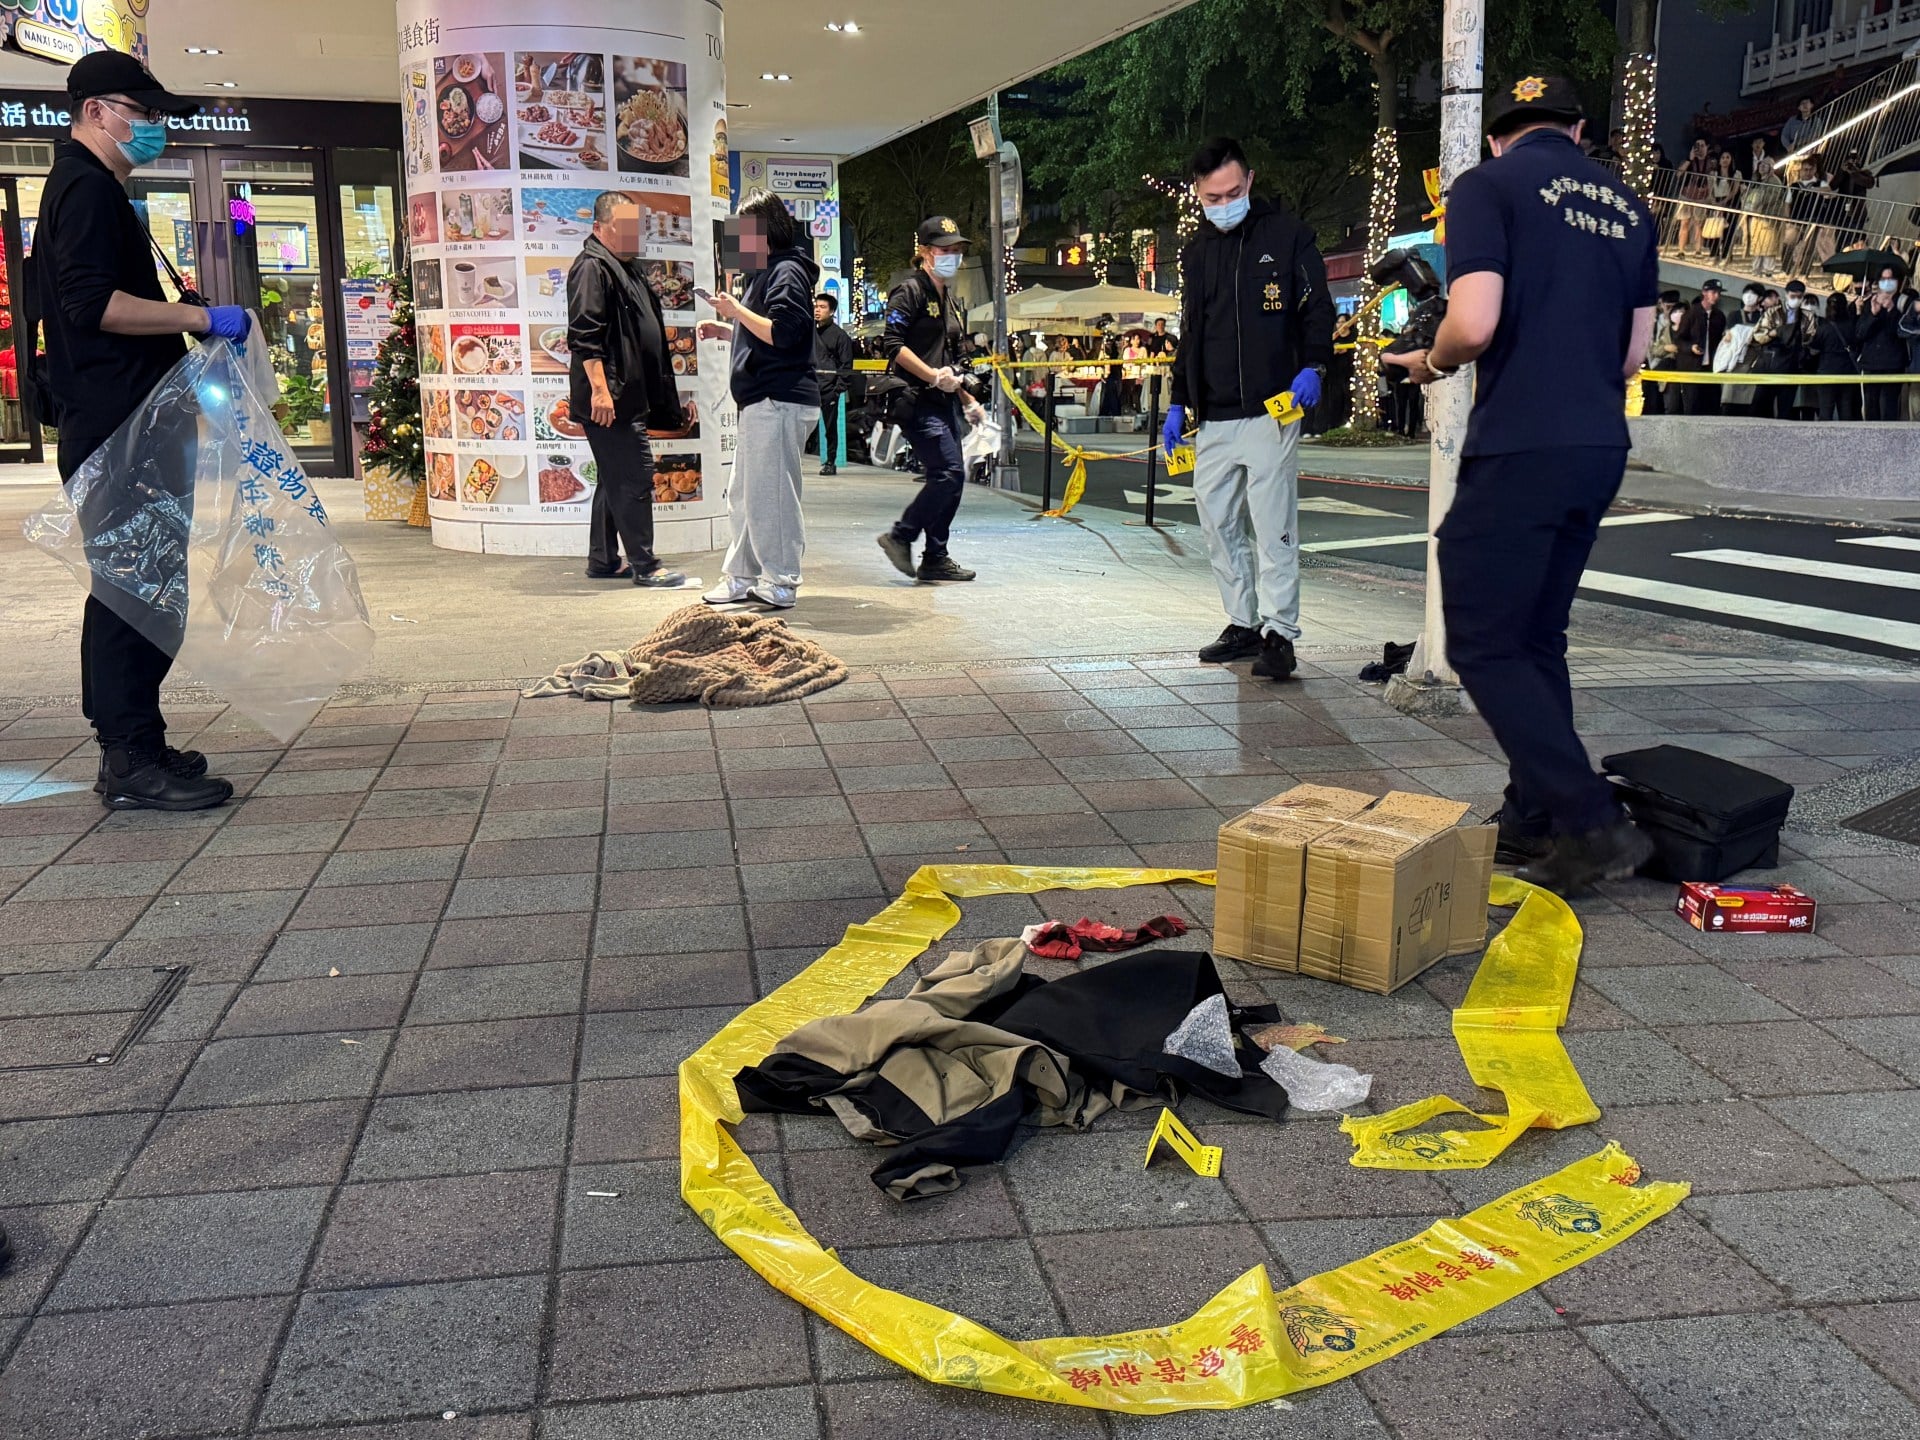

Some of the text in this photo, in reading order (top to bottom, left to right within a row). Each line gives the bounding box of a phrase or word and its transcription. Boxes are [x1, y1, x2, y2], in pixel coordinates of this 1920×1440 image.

[24, 29, 74, 53] NANXI SOHO
[399, 18, 440, 54] 美食街
[706, 33, 724, 64] TO
[0, 102, 26, 127] 活
[33, 104, 251, 132] the ectrum
[798, 169, 827, 179] hungry?
[824, 257, 837, 265] GO!
[527, 310, 553, 318] LOVIN
[1263, 301, 1283, 311] CID
[1273, 399, 1284, 412] 3
[1176, 454, 1187, 465] 2
[1061, 1323, 1267, 1393] 警察管制線
